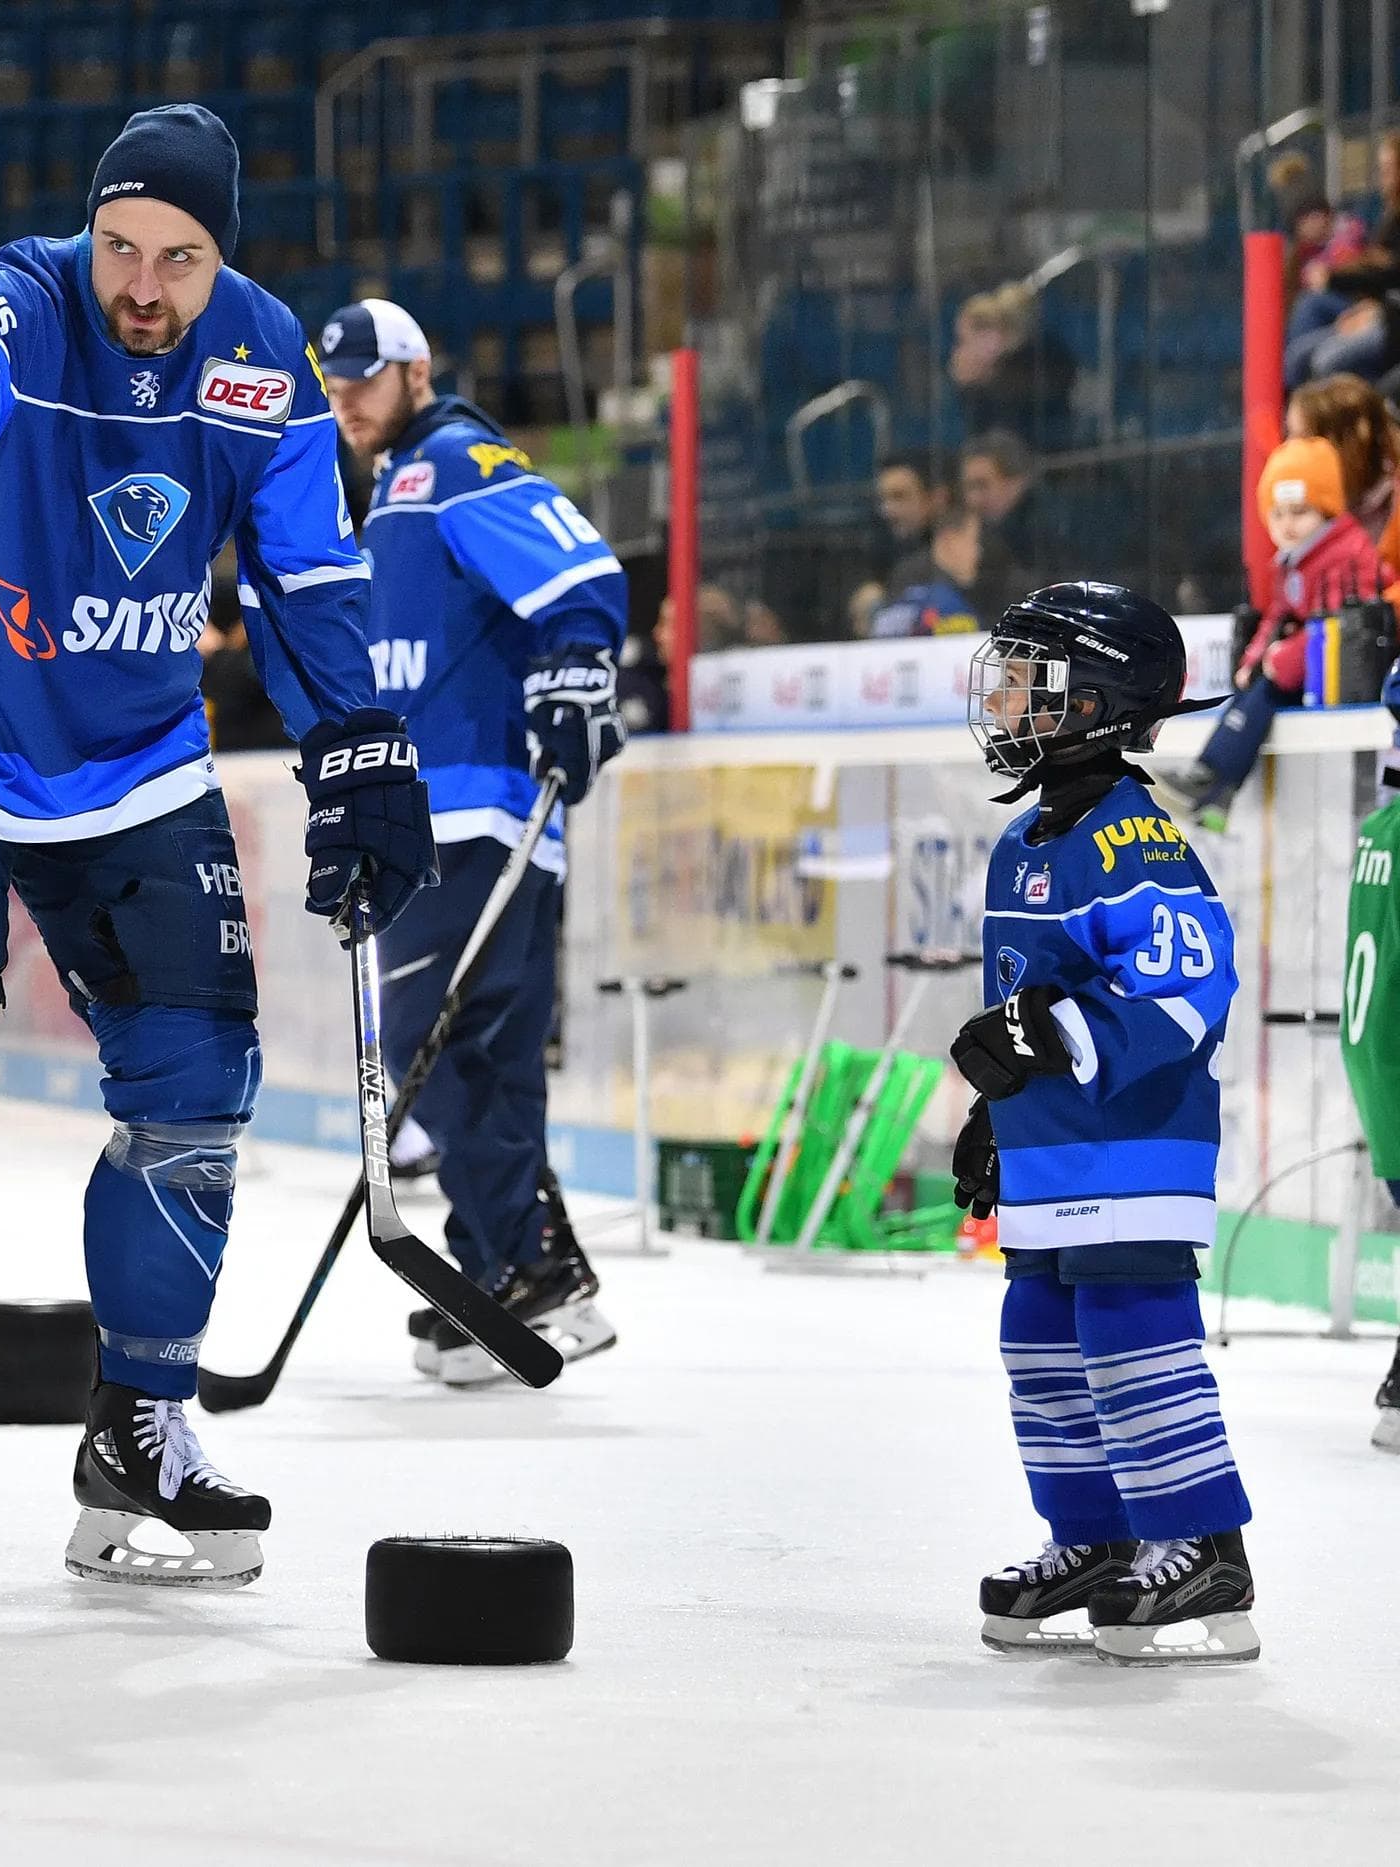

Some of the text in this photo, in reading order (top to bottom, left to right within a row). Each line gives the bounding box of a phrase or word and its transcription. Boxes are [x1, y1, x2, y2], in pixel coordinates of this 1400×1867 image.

[205, 377, 288, 412] DEL
[1134, 903, 1215, 979] 39
[1004, 987, 1035, 1058] CM
[159, 1342, 198, 1361] JERS
